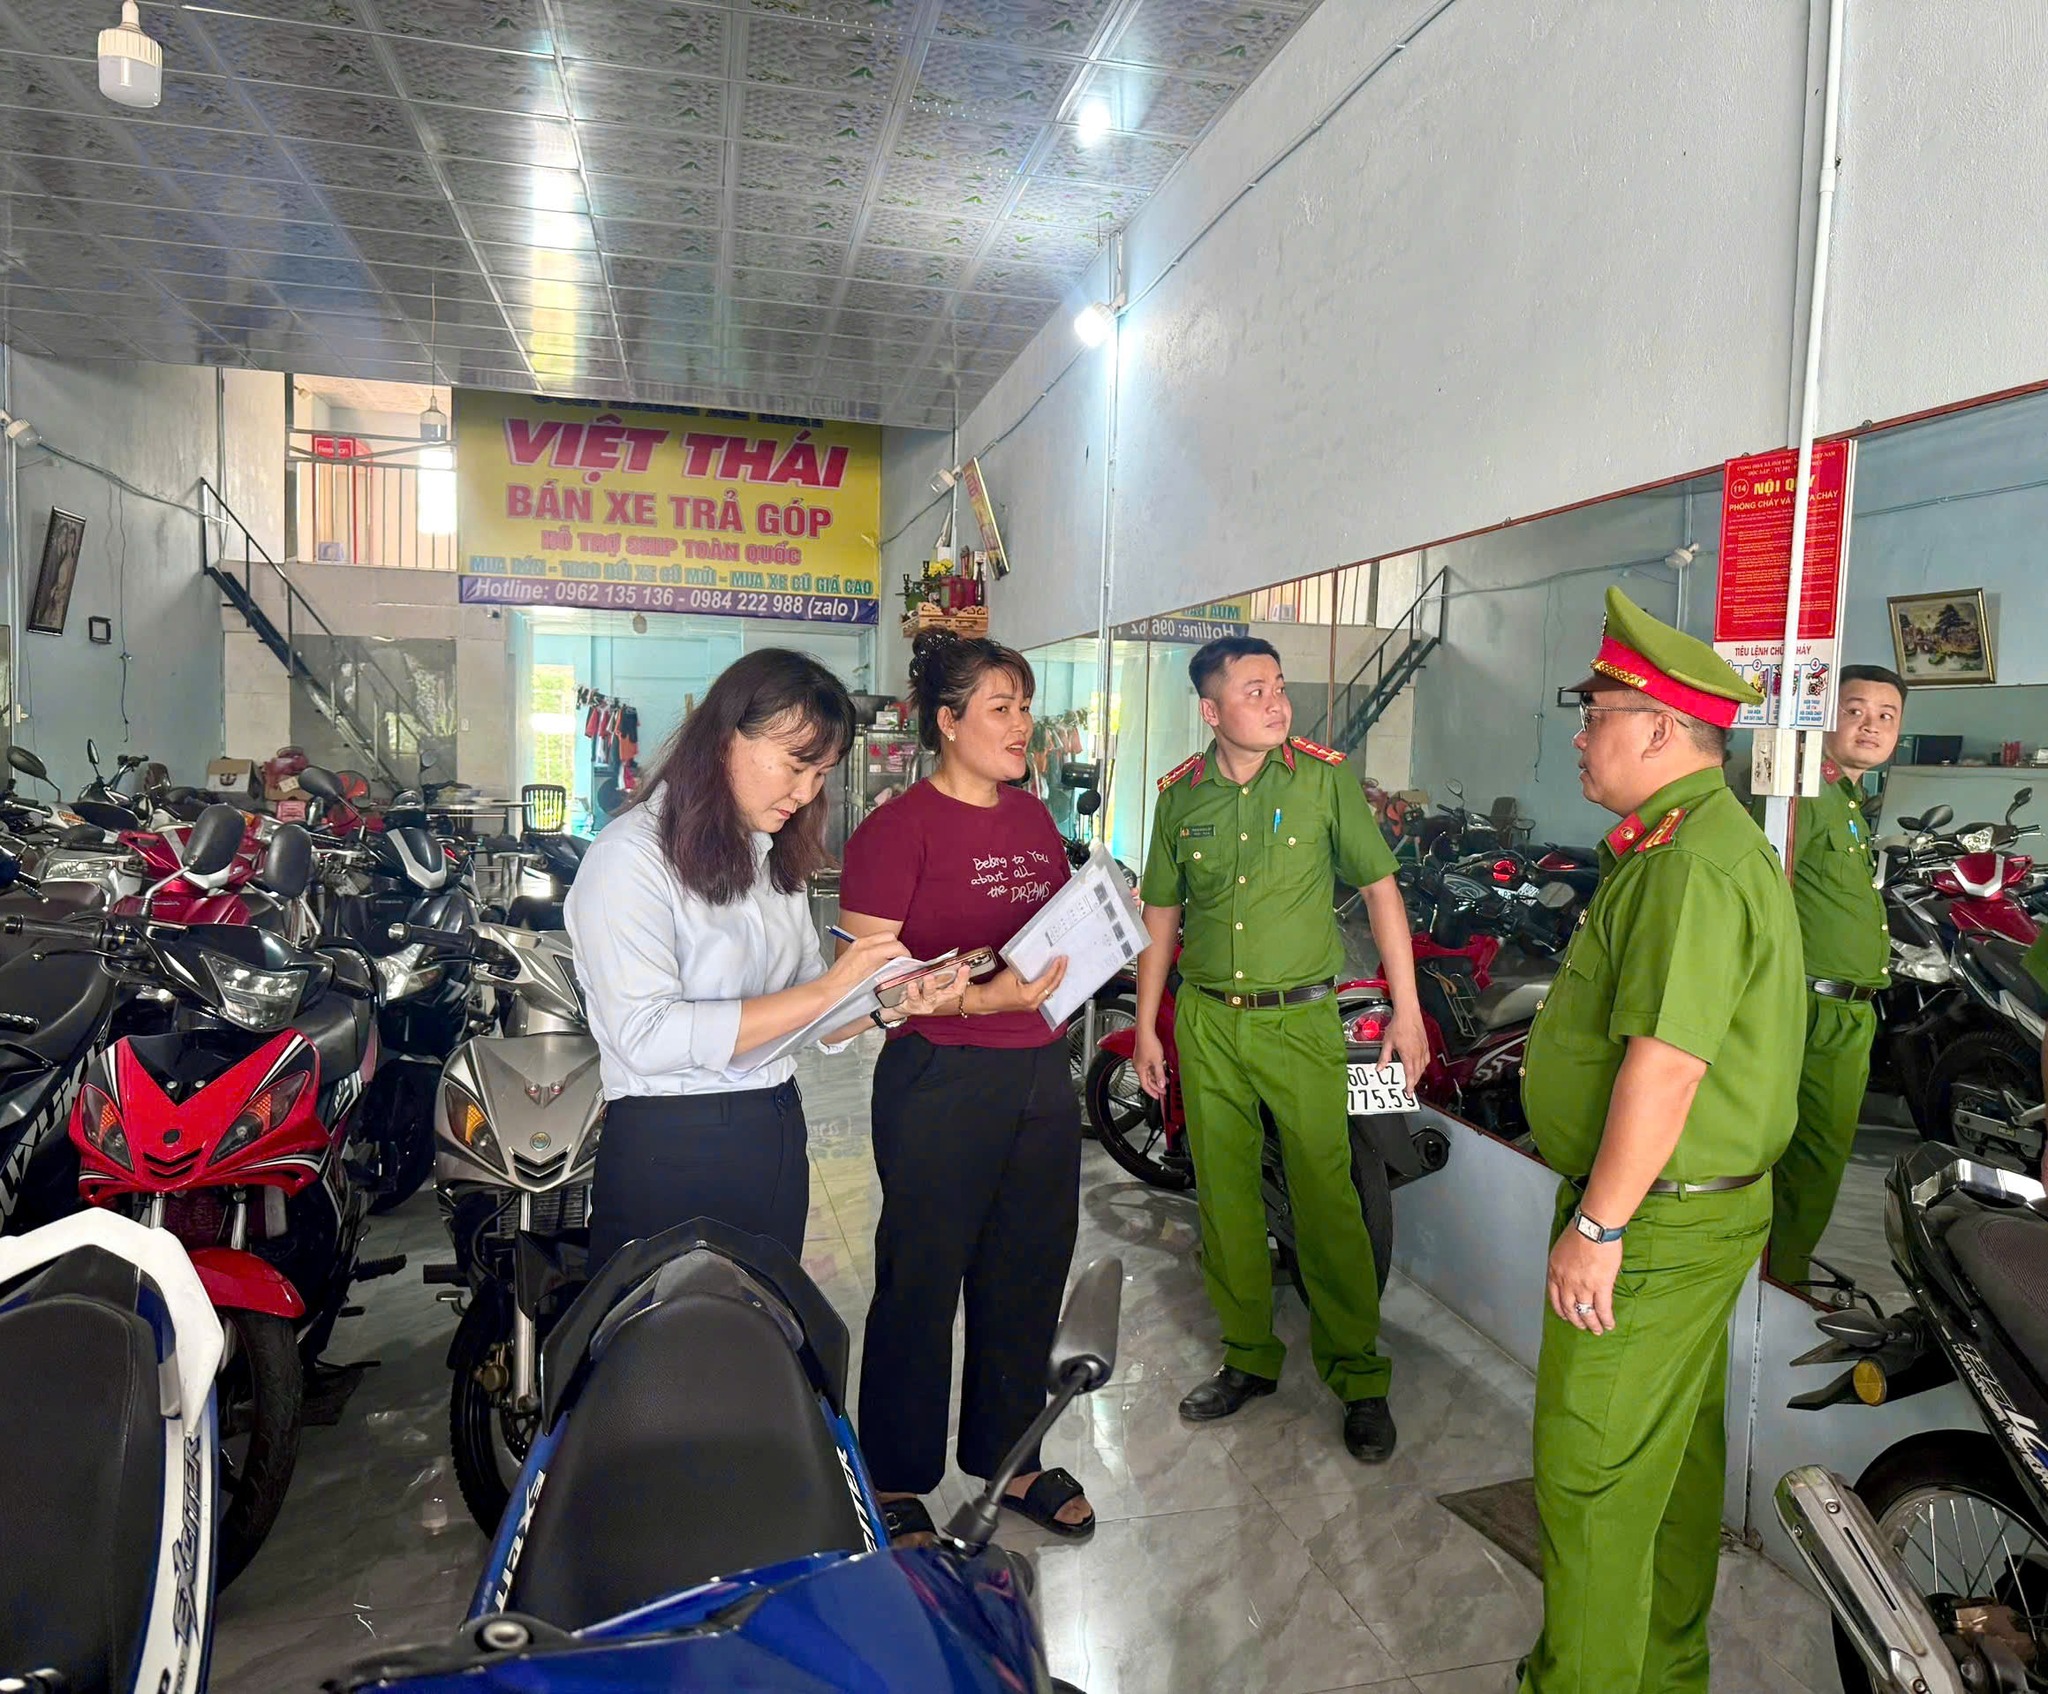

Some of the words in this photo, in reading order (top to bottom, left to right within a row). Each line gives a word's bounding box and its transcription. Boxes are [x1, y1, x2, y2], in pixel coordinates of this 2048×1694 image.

[505, 413, 669, 484] VIỆT
[683, 428, 849, 489] THÁI
[1733, 484, 1746, 493] 114
[1754, 479, 1780, 496] NỘI
[1785, 475, 1816, 492] QY
[507, 478, 593, 523] BÁN
[604, 488, 657, 527] XE
[669, 488, 745, 533] TRẢ
[757, 497, 833, 539] GÓP
[1758, 498, 1779, 508] CHÁY
[577, 531, 621, 557] TRỢ
[626, 535, 678, 557] SHIP
[682, 537, 740, 561] TOÀN
[745, 540, 802, 566] QUỐC
[730, 571, 764, 589] MUA
[767, 572, 789, 591] XE
[791, 572, 812, 592] CŨ
[815, 574, 841, 594] GIÁ
[844, 579, 874, 596] CAO
[477, 578, 549, 599] Hotline:
[555, 582, 599, 601] 0962
[605, 585, 636, 604] 135
[643, 586, 674, 606] 136
[690, 589, 732, 609] 0984
[737, 592, 768, 612] 222
[773, 595, 803, 614] 988
[1796, 644, 1811, 655] HÁY
[972, 854, 1007, 871] Belong
[1011, 855, 1025, 864] to
[971, 871, 1009, 885] about
[987, 885, 1008, 898] the
[1010, 881, 1051, 903] DREAMS
[172, 1434, 201, 1647] EXCITER
